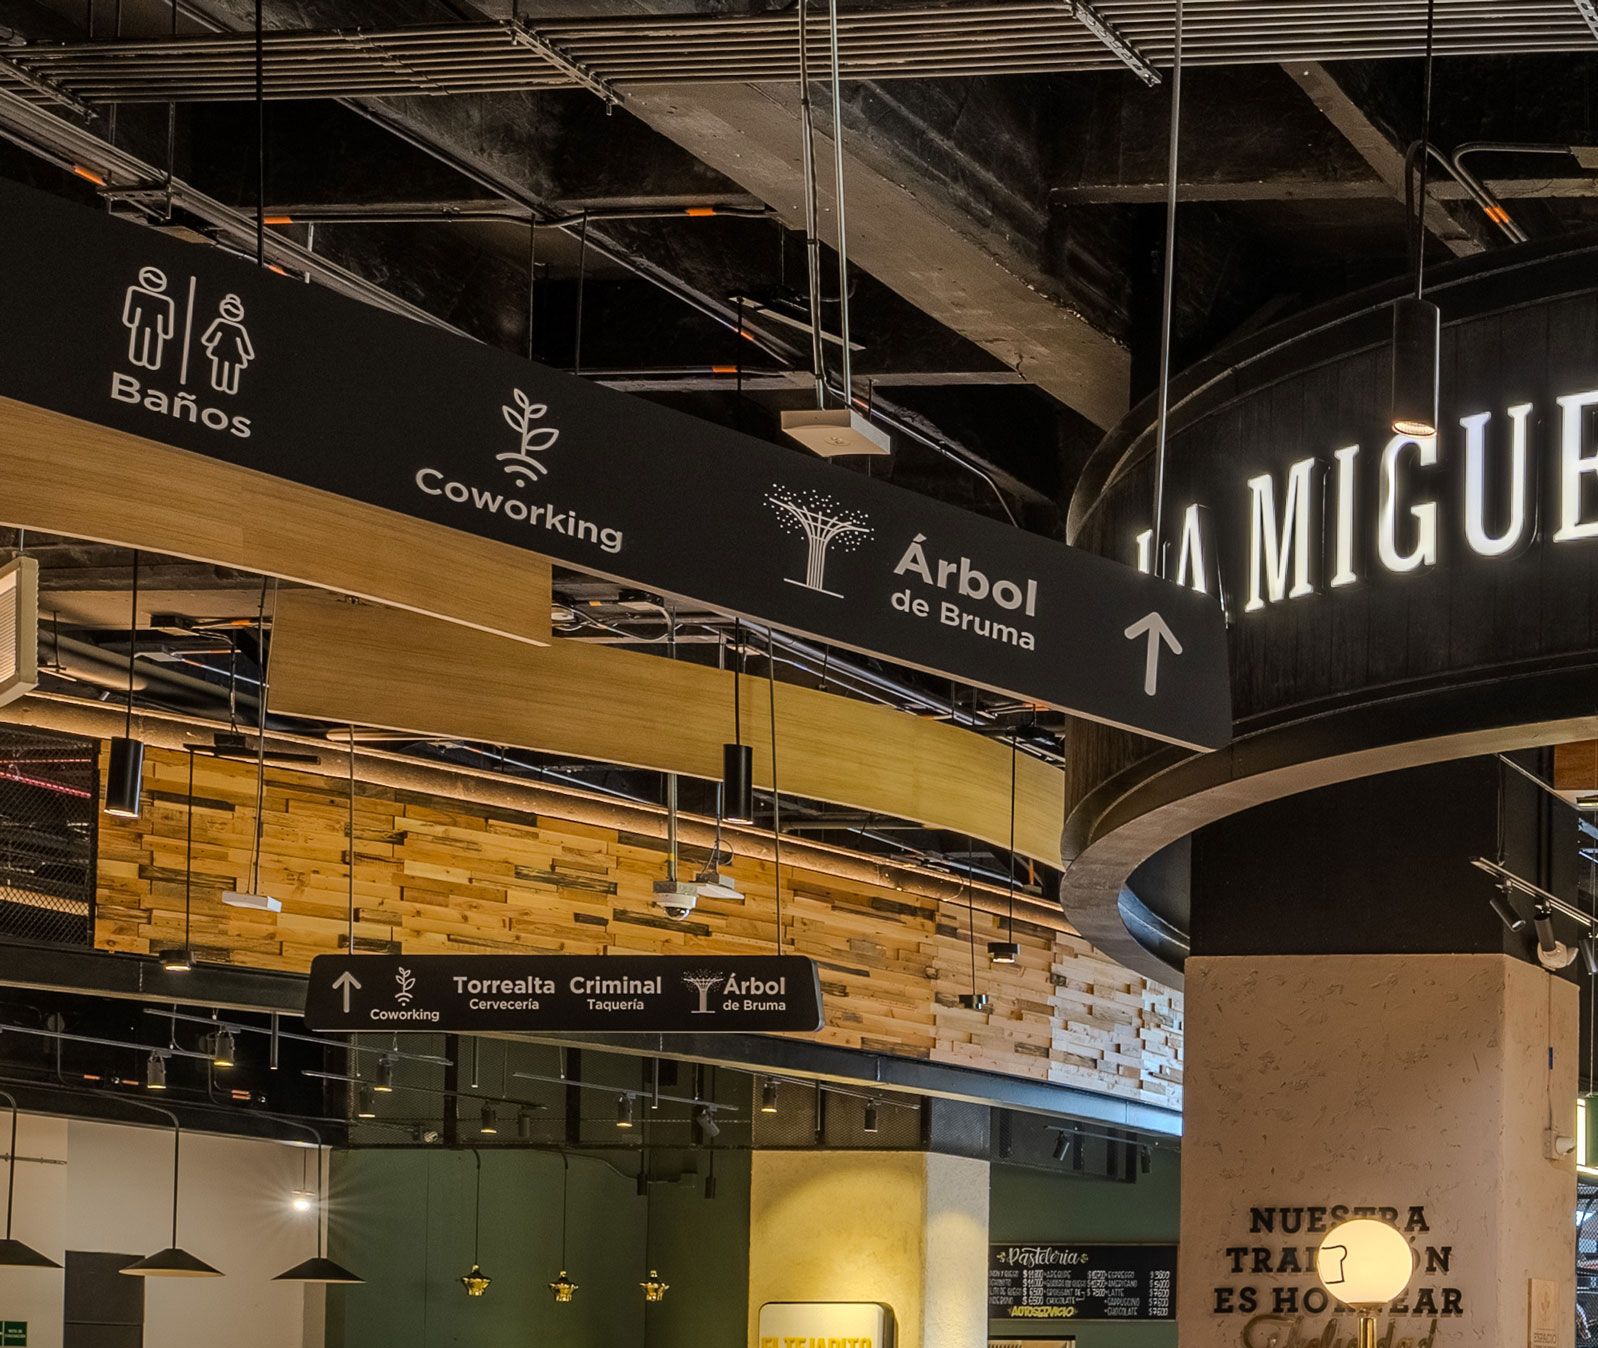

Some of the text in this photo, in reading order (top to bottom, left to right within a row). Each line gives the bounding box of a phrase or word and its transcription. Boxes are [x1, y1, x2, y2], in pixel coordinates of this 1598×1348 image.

[110, 371, 252, 439] Baños
[415, 467, 624, 554] Coworking
[892, 533, 1038, 617] Árbol
[890, 588, 1037, 651] de Bruma
[453, 976, 556, 995] Torrealta
[569, 976, 662, 995] Criminal
[723, 972, 786, 995] Árbol
[370, 1009, 440, 1022] Coworking
[469, 999, 540, 1011] Cervecería
[587, 999, 645, 1012] Taquería
[723, 1000, 787, 1011] de Bruma
[1214, 1288, 1257, 1313] ES
